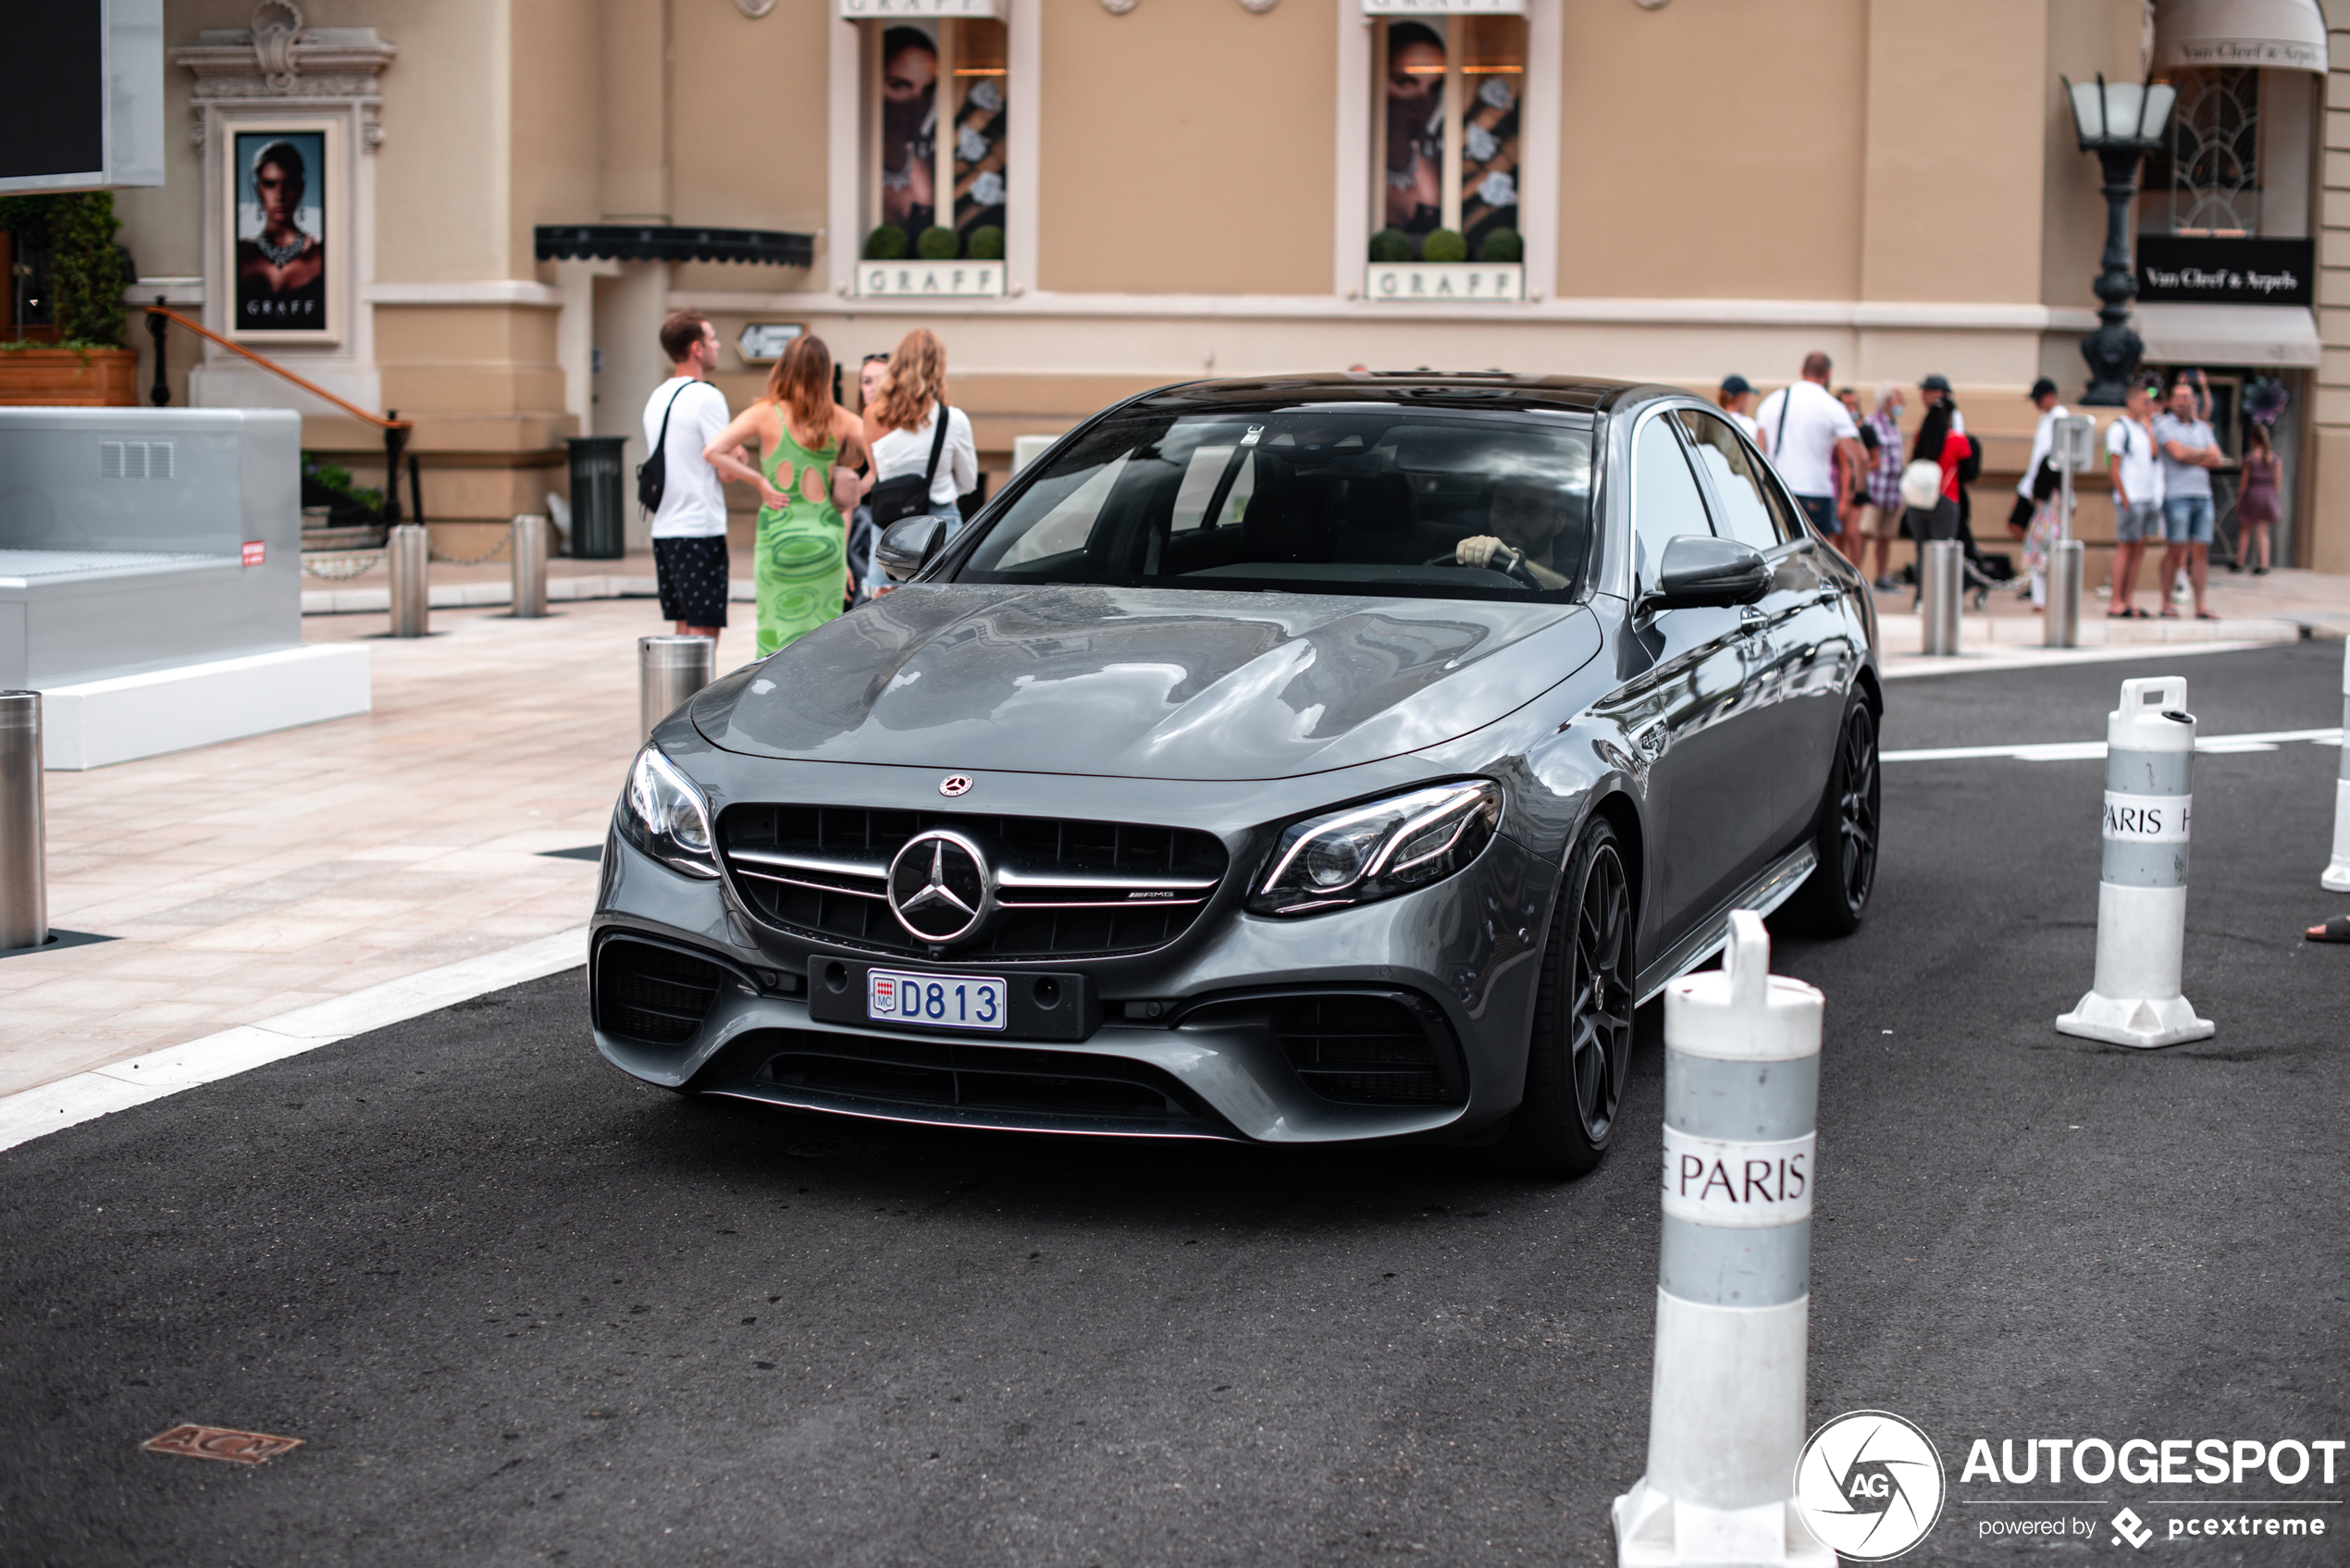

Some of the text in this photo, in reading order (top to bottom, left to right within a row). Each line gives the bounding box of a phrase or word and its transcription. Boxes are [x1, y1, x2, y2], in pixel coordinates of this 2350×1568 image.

[868, 269, 992, 290] GRAFF
[1379, 272, 1510, 294] GRAFF
[2145, 266, 2299, 295] Van Cleef & Arpels
[246, 299, 315, 315] GRAFF
[877, 980, 997, 1022] MC D813
[1681, 1153, 1806, 1204] PARIS
[158, 1429, 283, 1458] ACM
